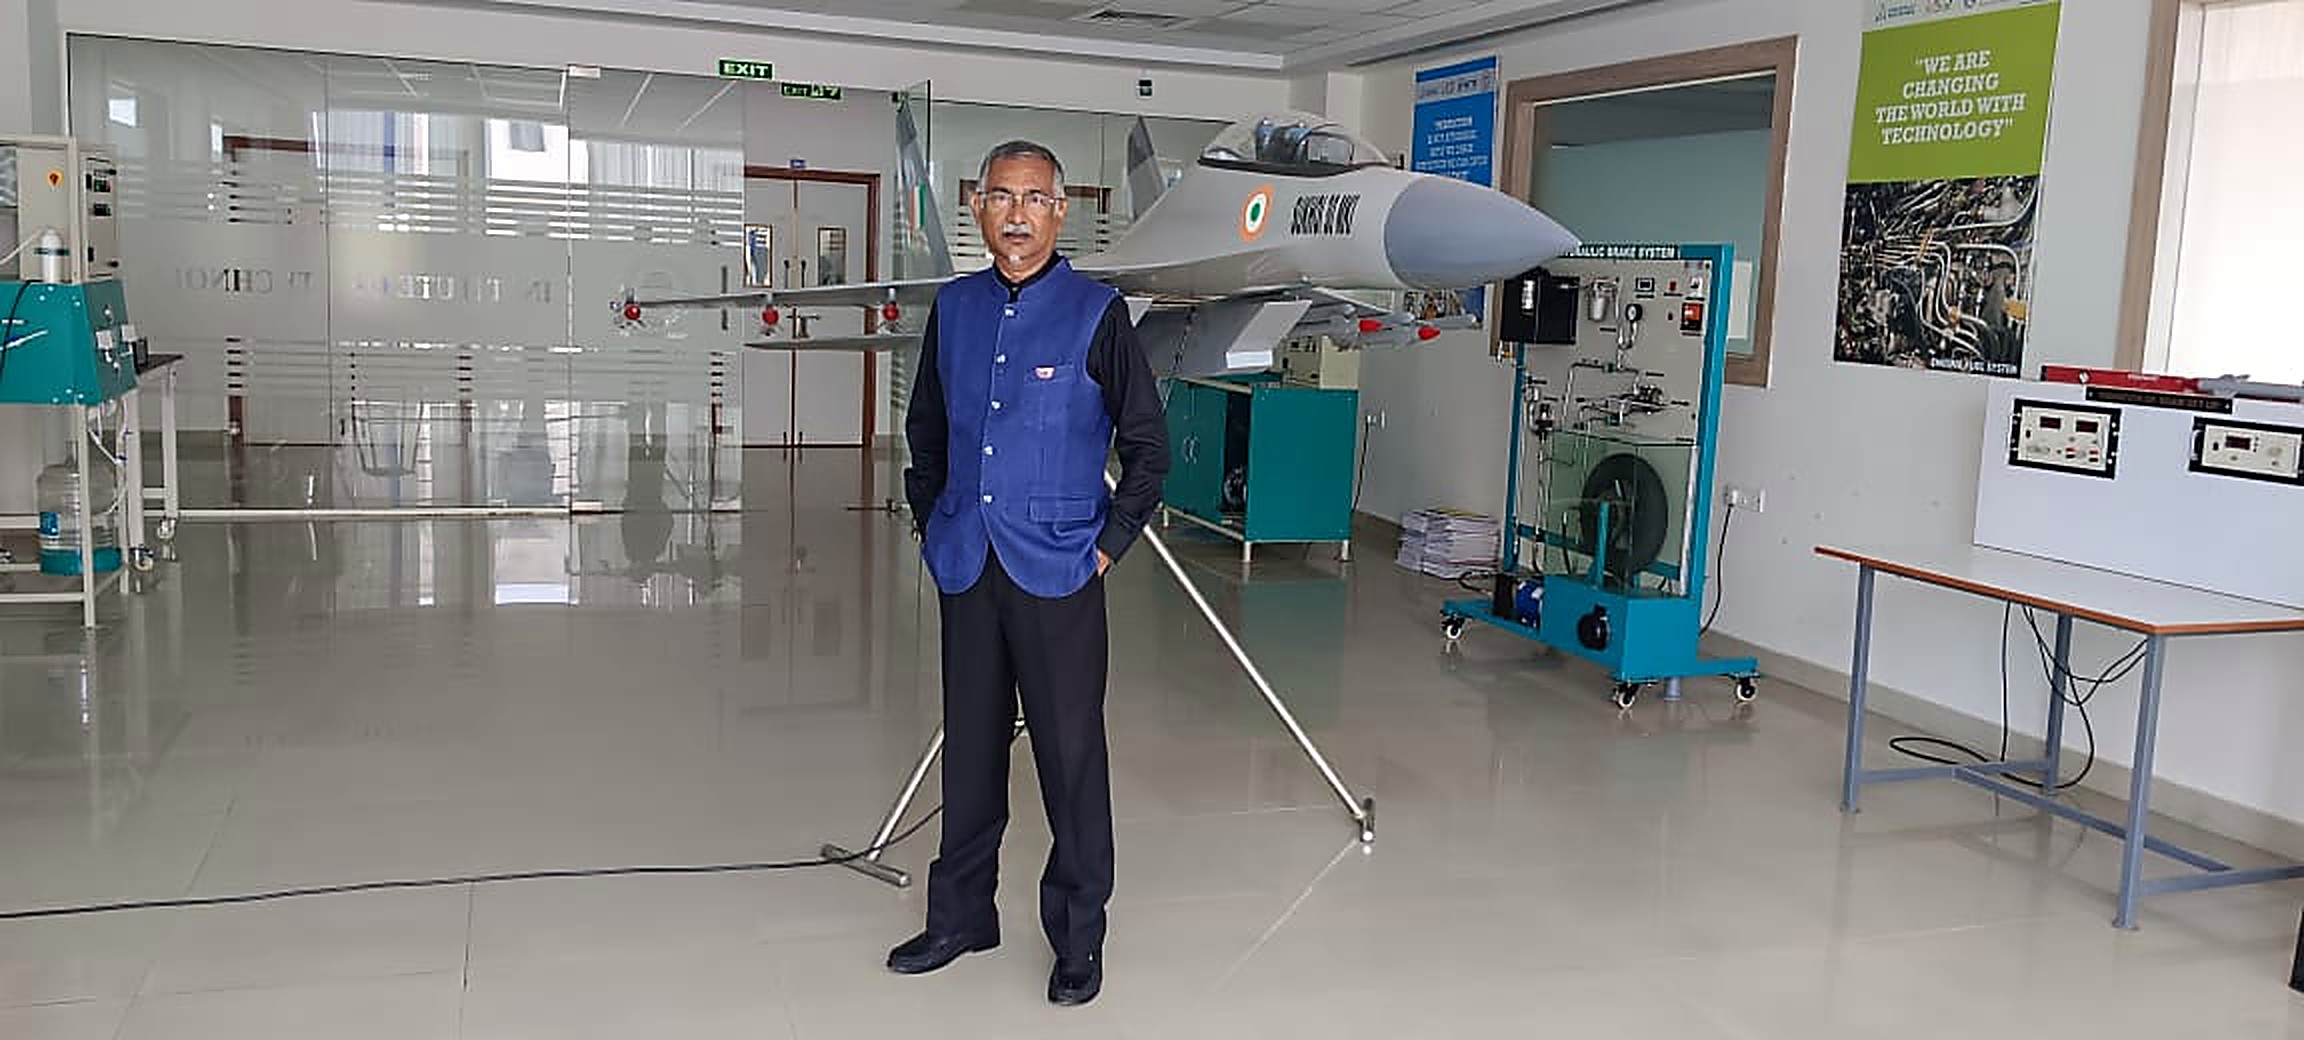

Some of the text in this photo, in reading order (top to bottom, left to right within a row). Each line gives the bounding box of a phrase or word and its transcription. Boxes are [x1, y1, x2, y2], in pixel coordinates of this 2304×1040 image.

[723, 63, 769, 77] EXIT
[1954, 50, 1991, 71] ARE
[1902, 73, 1999, 99] CHANGING
[1875, 93, 2027, 123] THE WORLD WITH
